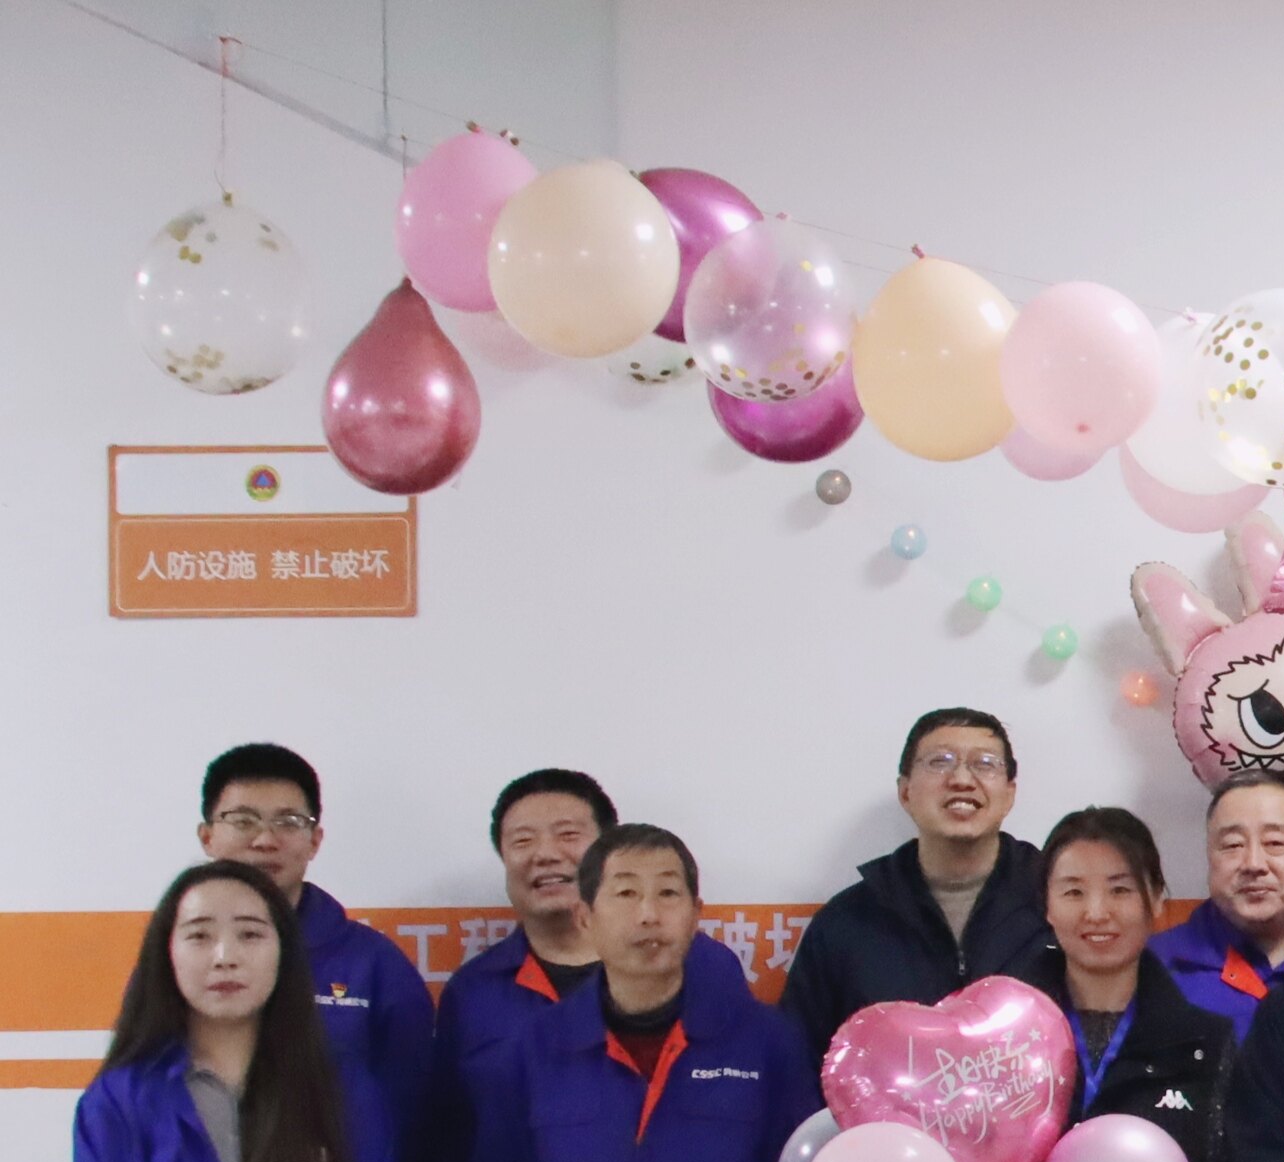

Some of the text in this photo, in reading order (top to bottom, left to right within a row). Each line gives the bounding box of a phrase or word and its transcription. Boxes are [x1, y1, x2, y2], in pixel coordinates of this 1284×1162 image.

[136, 549, 390, 581] 人防设施 禁止破坏
[691, 1068, 722, 1079] CSSC
